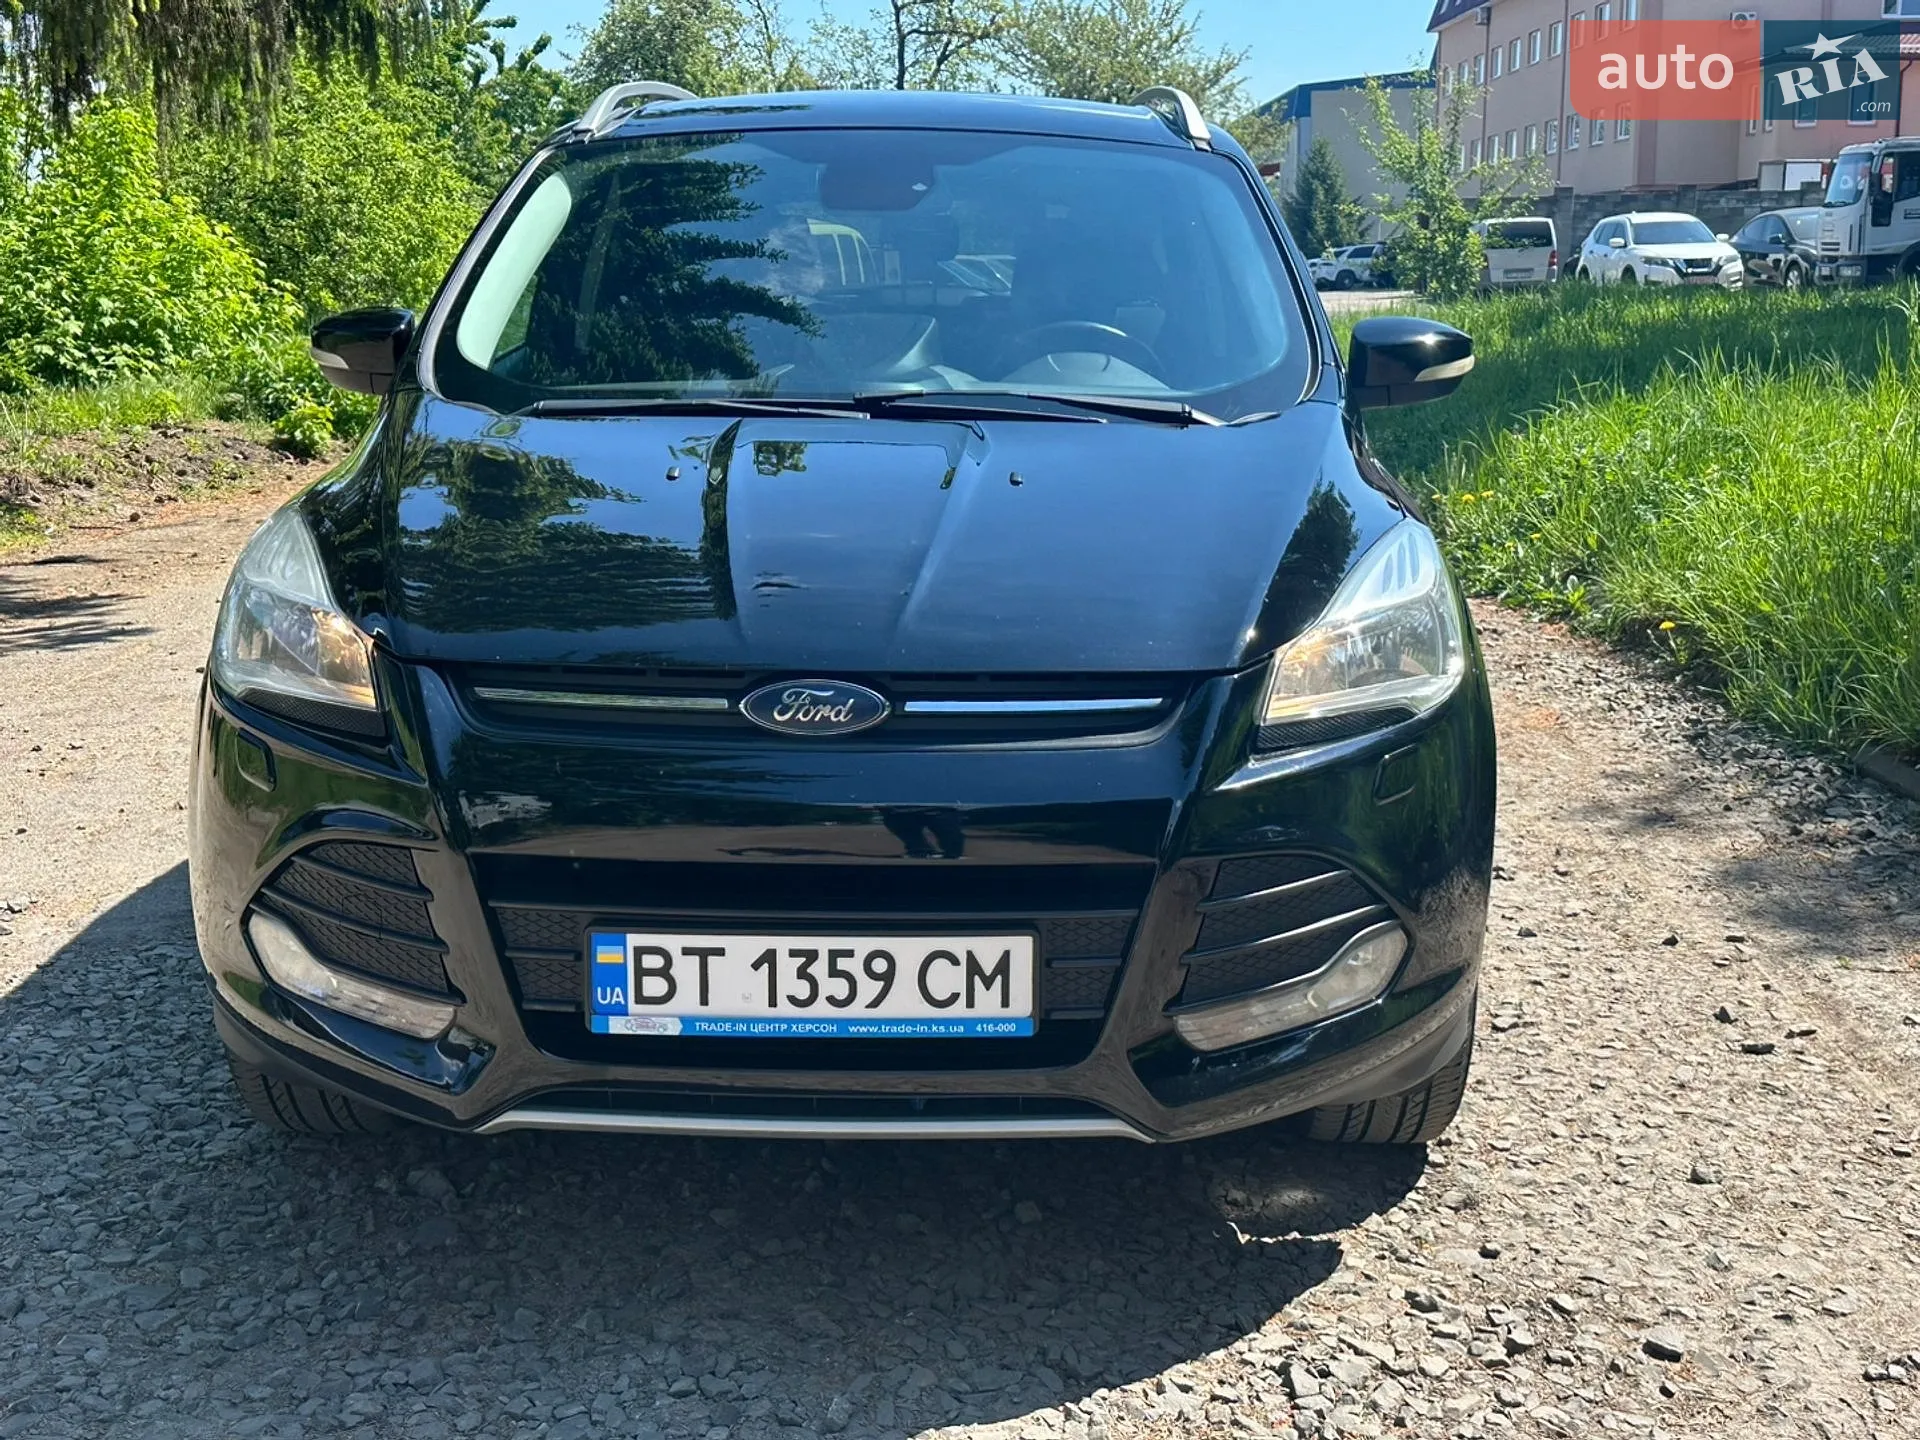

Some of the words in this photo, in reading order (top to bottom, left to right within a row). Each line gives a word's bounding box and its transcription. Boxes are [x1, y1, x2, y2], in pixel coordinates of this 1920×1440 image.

[773, 687, 855, 722] Ford
[633, 945, 726, 1007] BT
[750, 948, 896, 1009] 1359
[917, 949, 1010, 1009] CM
[597, 986, 626, 1005] UA
[694, 1022, 747, 1032] TRADE-IN
[750, 1023, 788, 1034] ЦЕНТР
[790, 1024, 837, 1033] ХЕРСОН
[848, 1022, 964, 1034] www.trade-in.ks.ua
[975, 1022, 1017, 1033] 416-000
